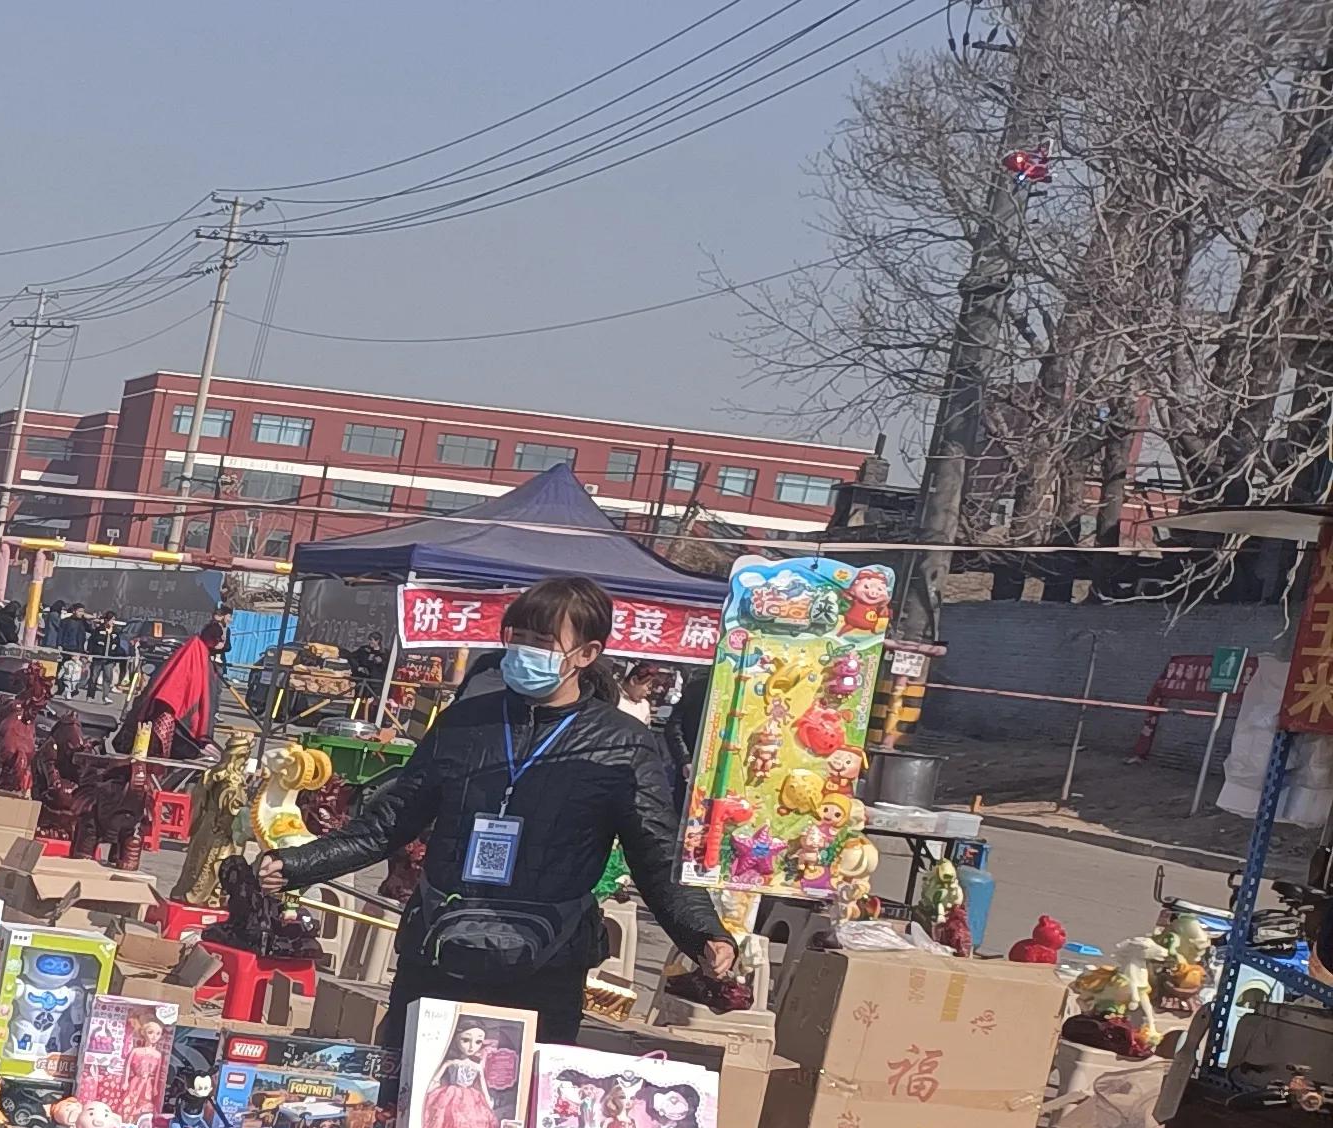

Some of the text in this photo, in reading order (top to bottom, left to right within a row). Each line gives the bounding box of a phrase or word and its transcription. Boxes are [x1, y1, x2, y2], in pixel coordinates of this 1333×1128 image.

[413, 598, 481, 632] 饼子
[680, 614, 719, 649] 麻
[290, 1081, 333, 1098] FORTNITE
[886, 1044, 944, 1102] 福
